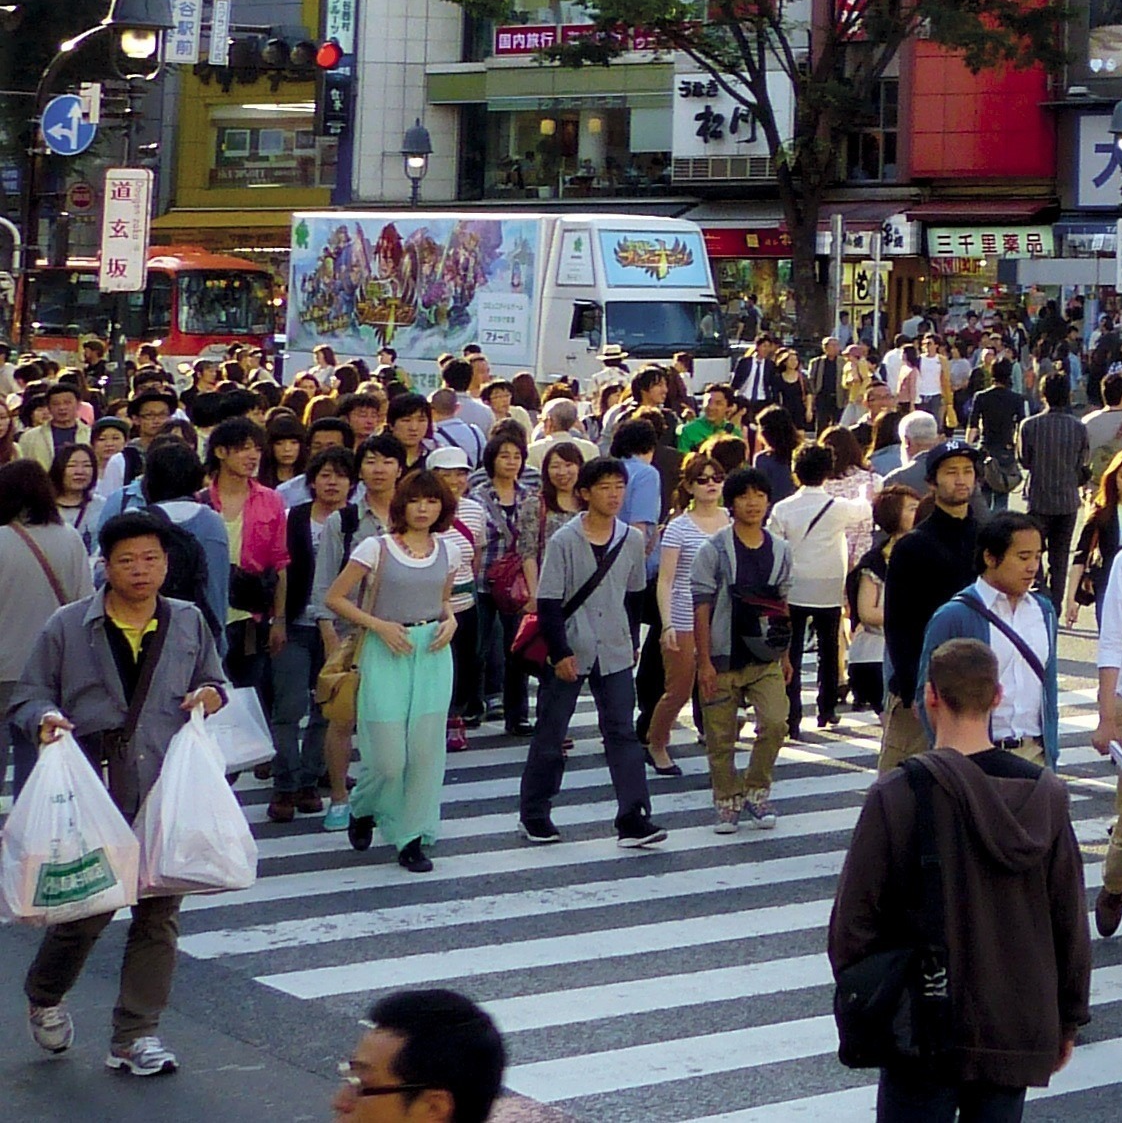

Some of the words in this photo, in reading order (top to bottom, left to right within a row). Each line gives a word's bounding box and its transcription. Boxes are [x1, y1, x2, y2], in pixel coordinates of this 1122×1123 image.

[498, 32, 554, 49] 国内旅行
[678, 80, 719, 99] うなぎ
[106, 181, 132, 278] 道玄坂
[937, 234, 1043, 255] 三千里薬品
